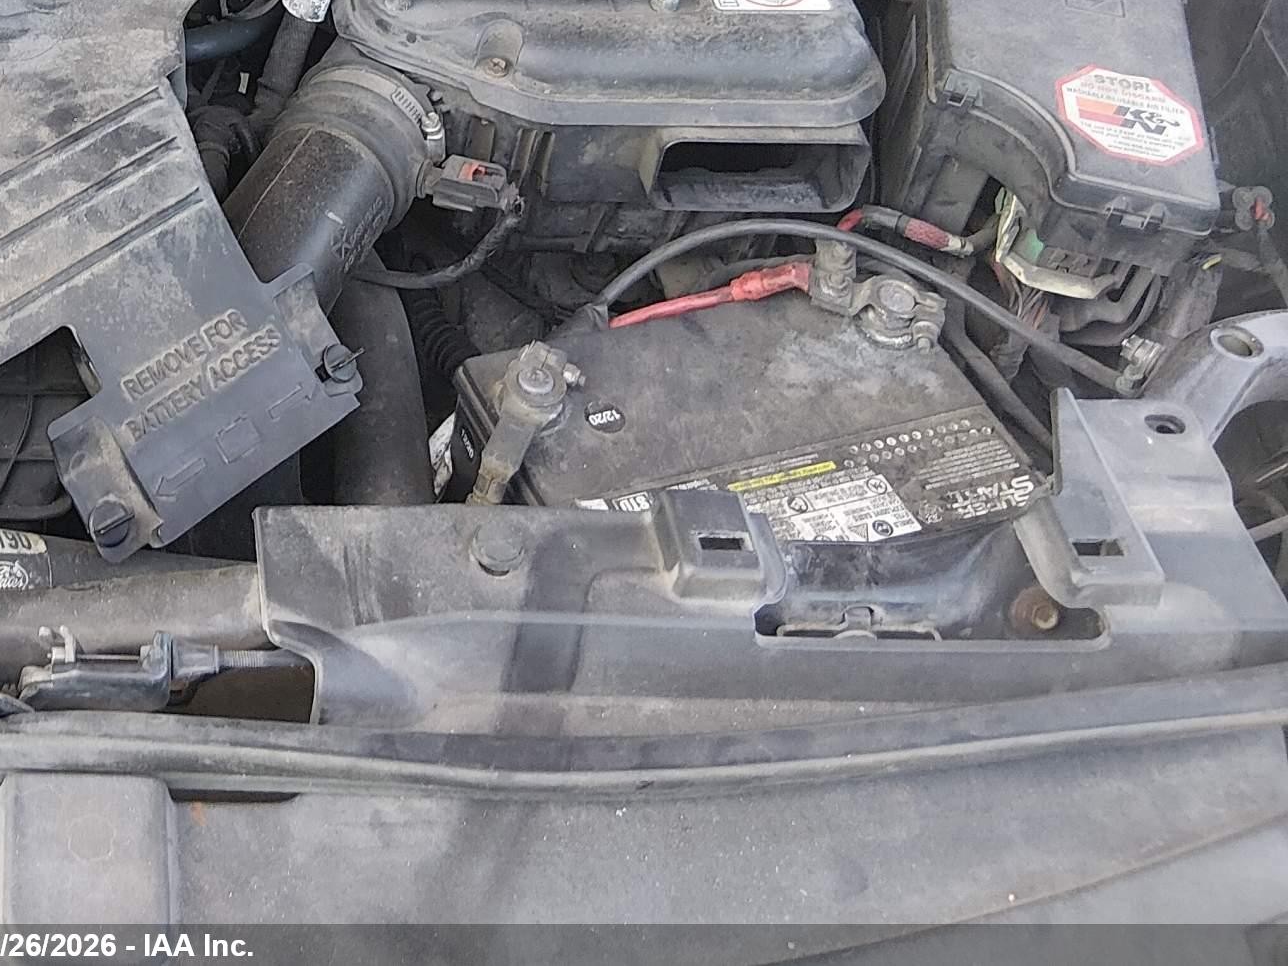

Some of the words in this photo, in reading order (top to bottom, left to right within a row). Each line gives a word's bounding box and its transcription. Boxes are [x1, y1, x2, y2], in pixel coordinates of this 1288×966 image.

[121, 336, 205, 403] REMOVE
[202, 308, 248, 348] FOR
[123, 377, 209, 442] BATTERY
[209, 324, 281, 389] ACCESS
